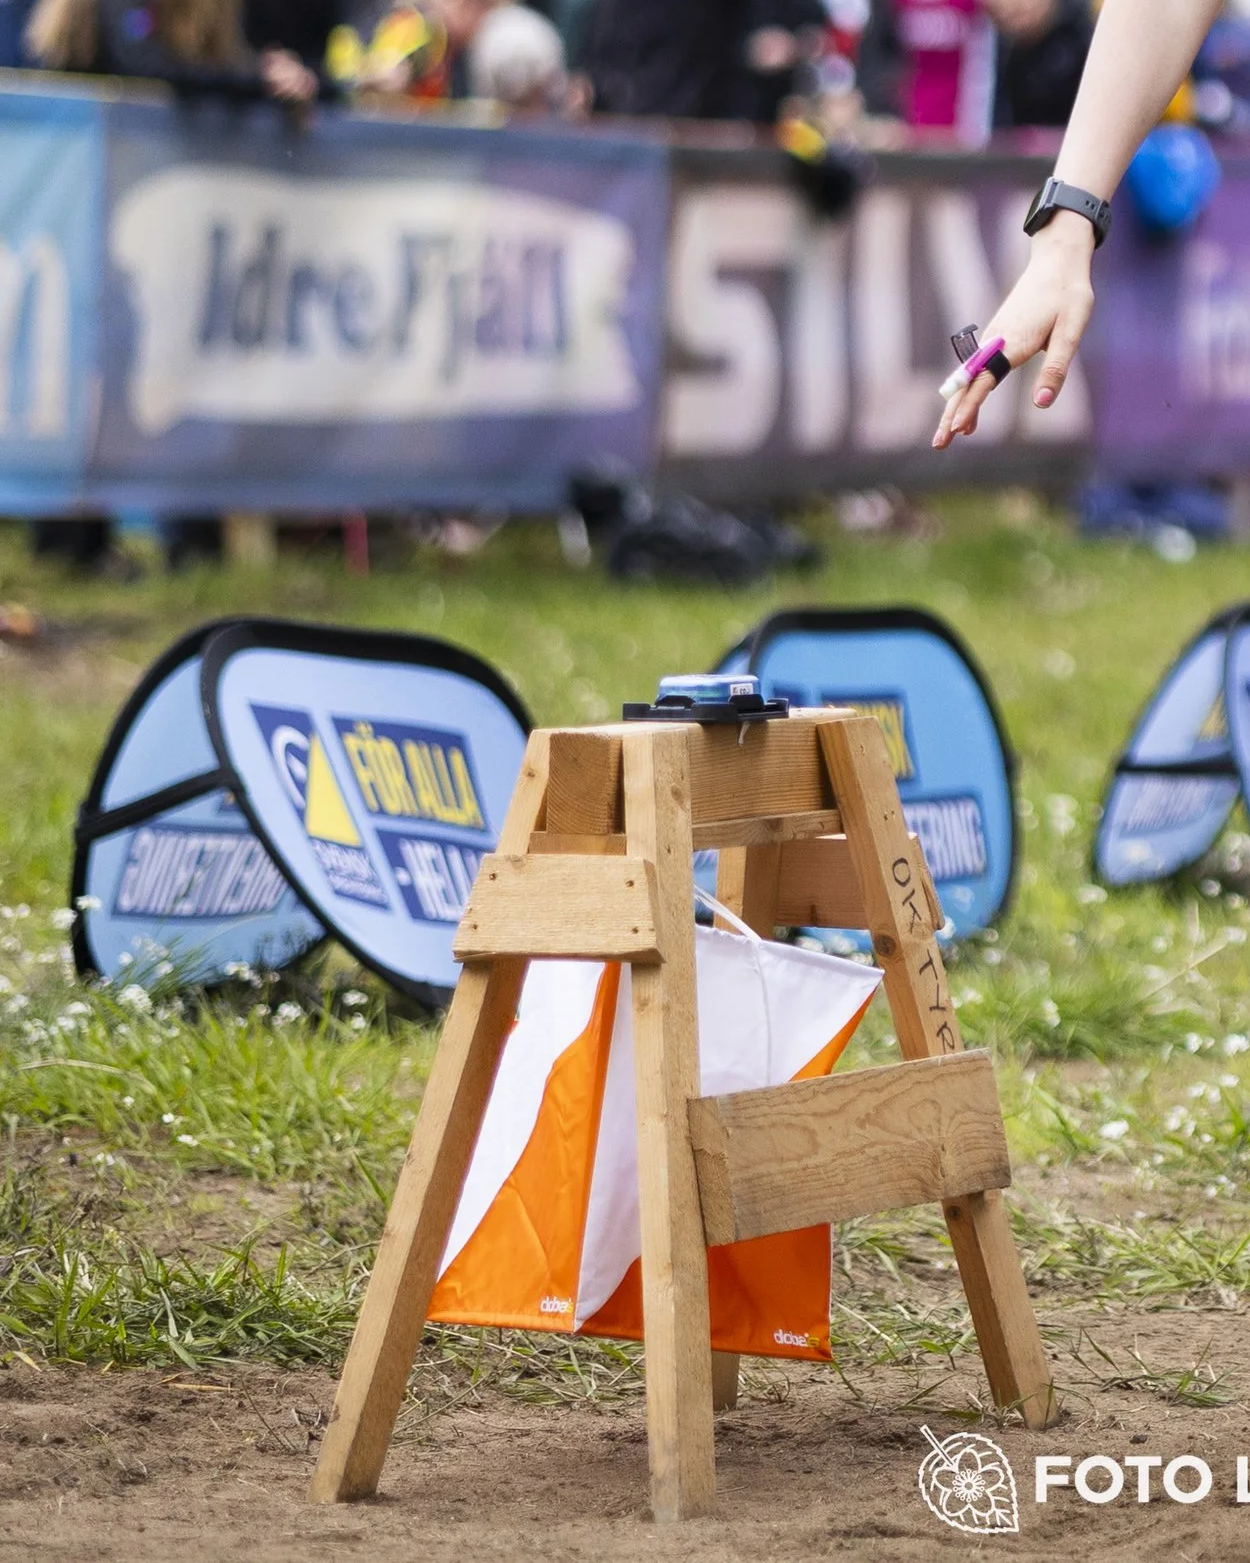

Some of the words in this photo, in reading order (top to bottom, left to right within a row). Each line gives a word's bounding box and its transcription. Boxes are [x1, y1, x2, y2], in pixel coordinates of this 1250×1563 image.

[343, 720, 419, 815] FÖR
[403, 739, 485, 830] ALLA
[891, 857, 922, 933] OK
